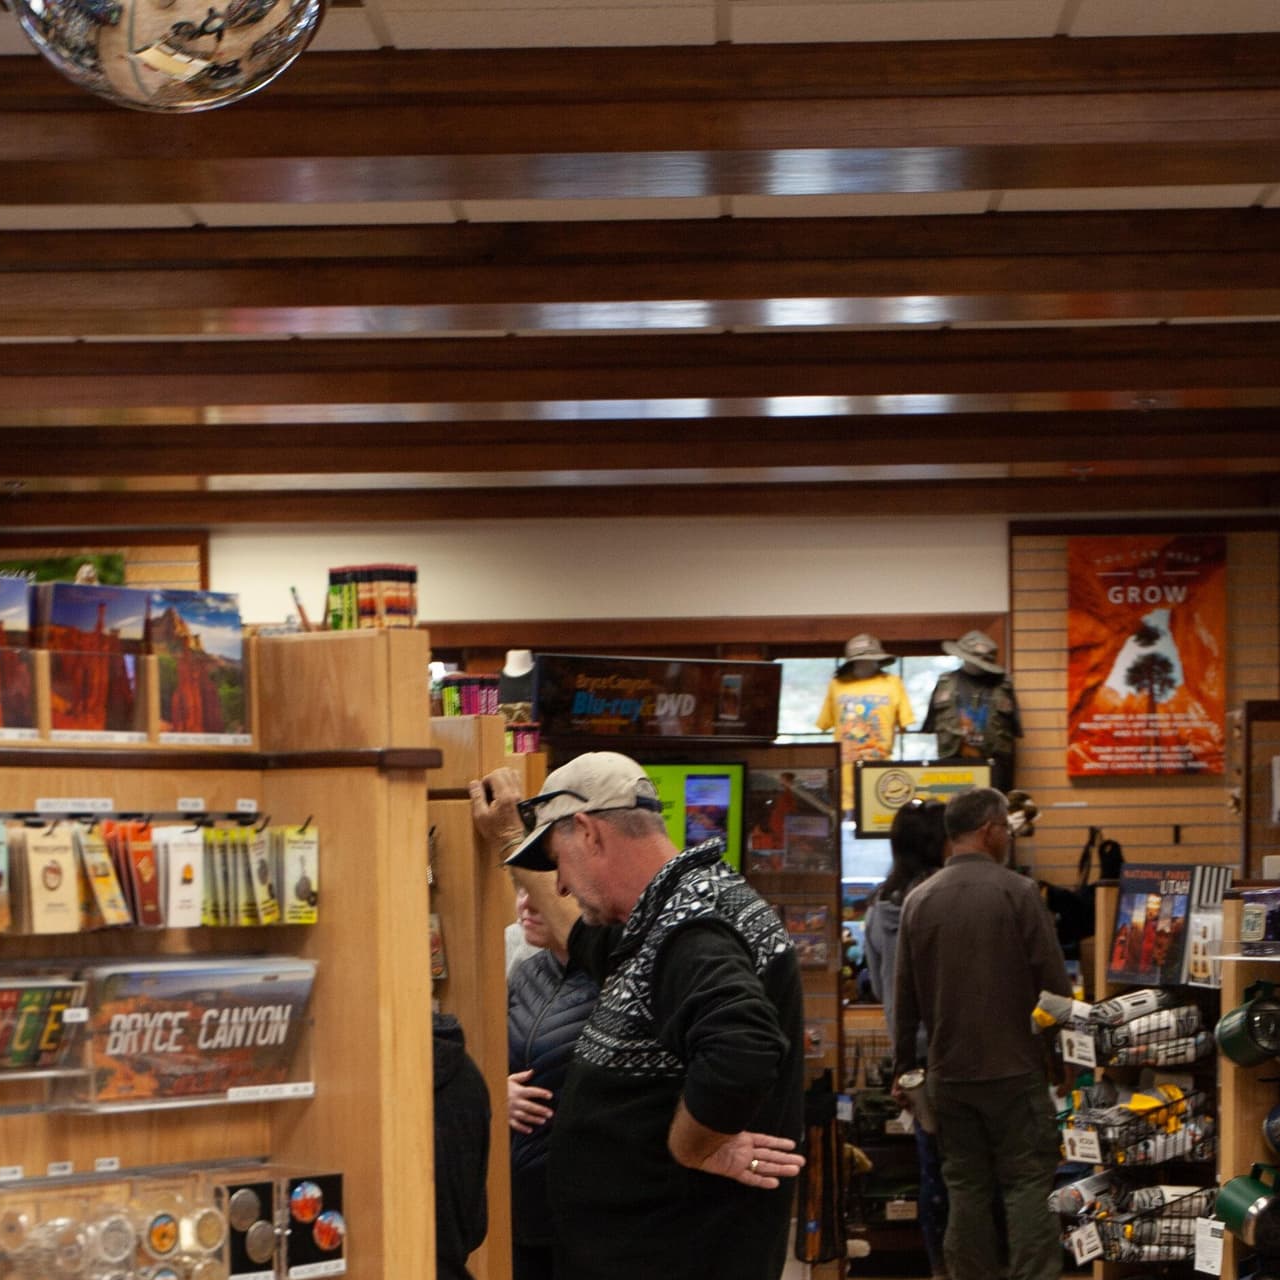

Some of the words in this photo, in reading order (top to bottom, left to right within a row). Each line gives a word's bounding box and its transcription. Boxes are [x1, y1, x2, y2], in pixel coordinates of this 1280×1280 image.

[1107, 586, 1188, 604] GROW
[572, 691, 644, 722] Blu-ray
[655, 693, 696, 717] DVD
[1159, 880, 1191, 895] UTAH
[106, 1010, 191, 1056] BRYCE
[197, 1004, 292, 1050] CANYON
